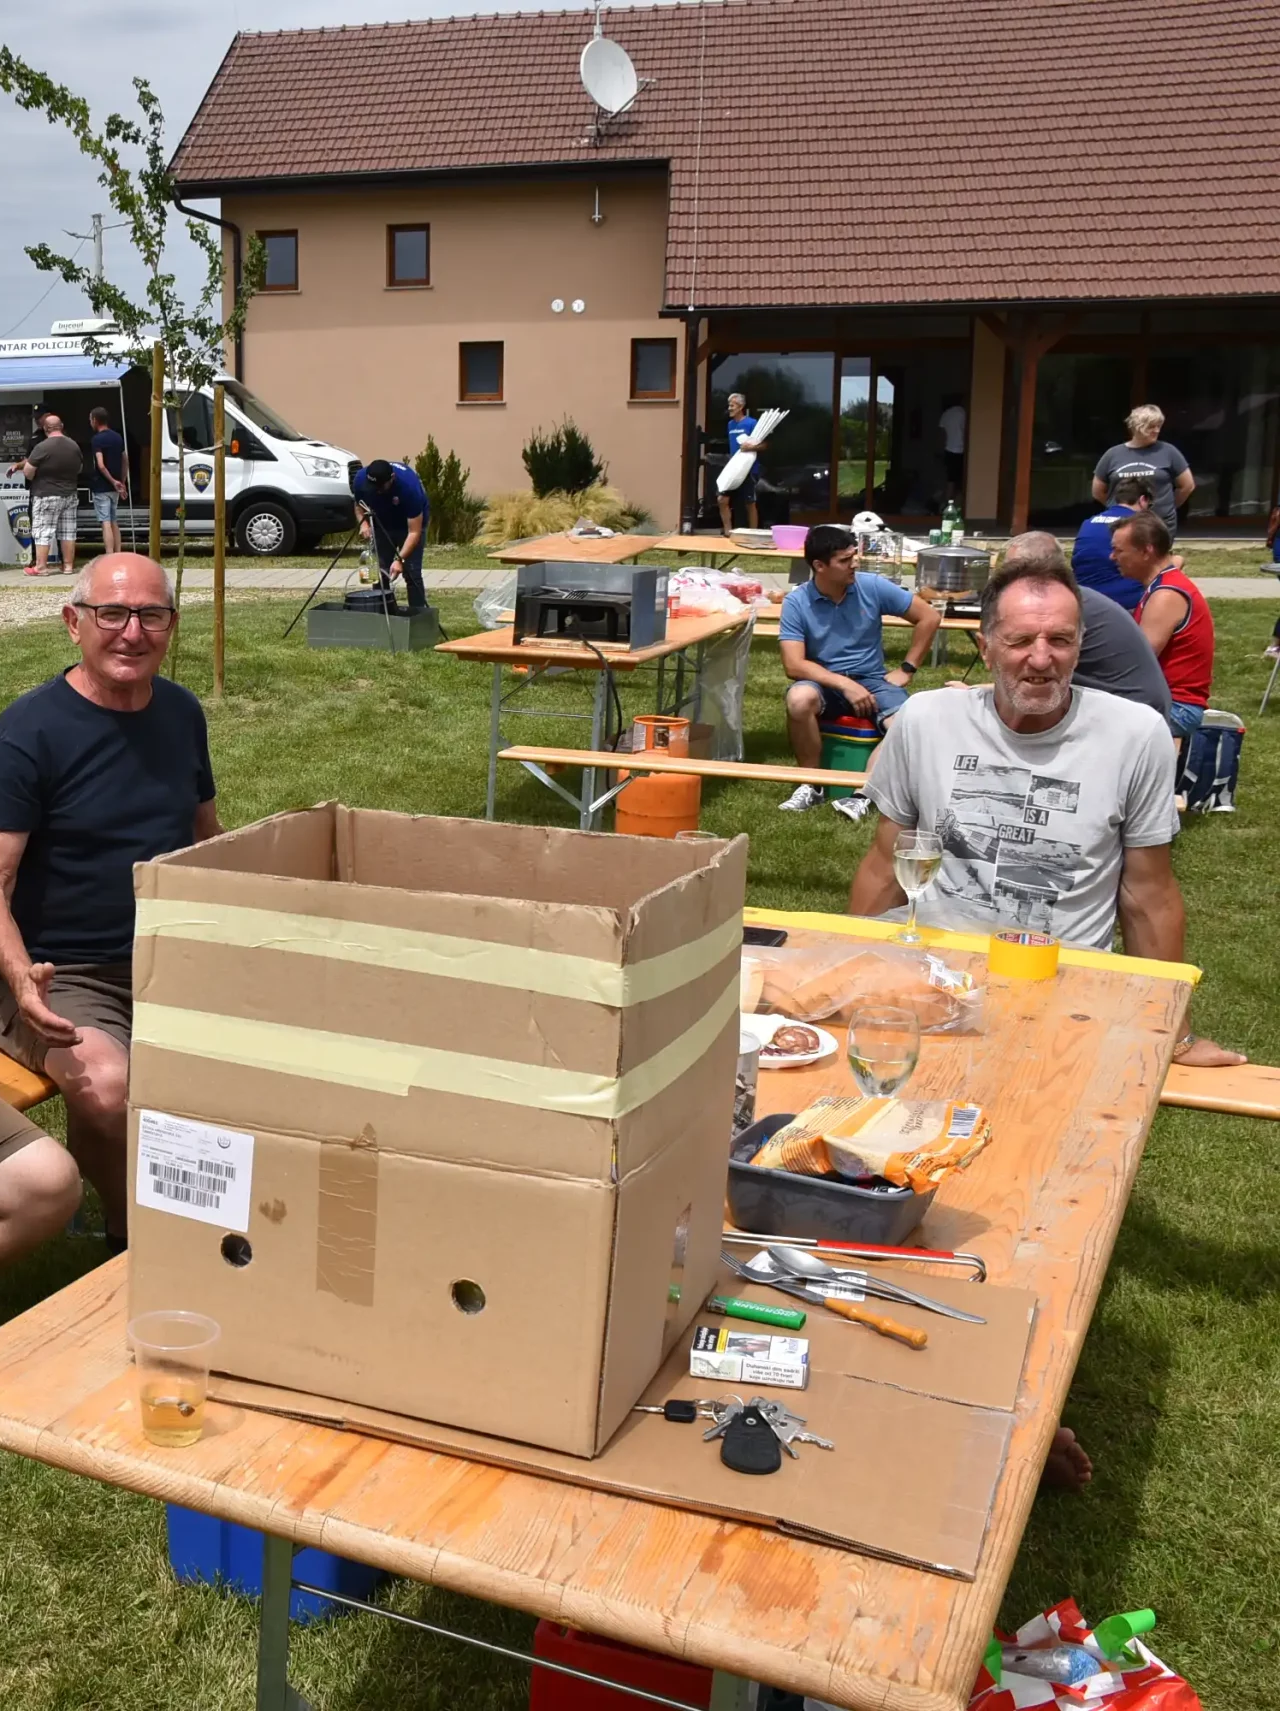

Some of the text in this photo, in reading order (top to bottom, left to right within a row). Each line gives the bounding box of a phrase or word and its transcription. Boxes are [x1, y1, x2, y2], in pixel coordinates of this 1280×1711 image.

[30, 340, 81, 351] POLICIJE
[1118, 470, 1155, 478] WHATEVER
[955, 756, 978, 770] LIFE
[1025, 808, 1047, 825] IS A
[998, 826, 1035, 843] GREAT
